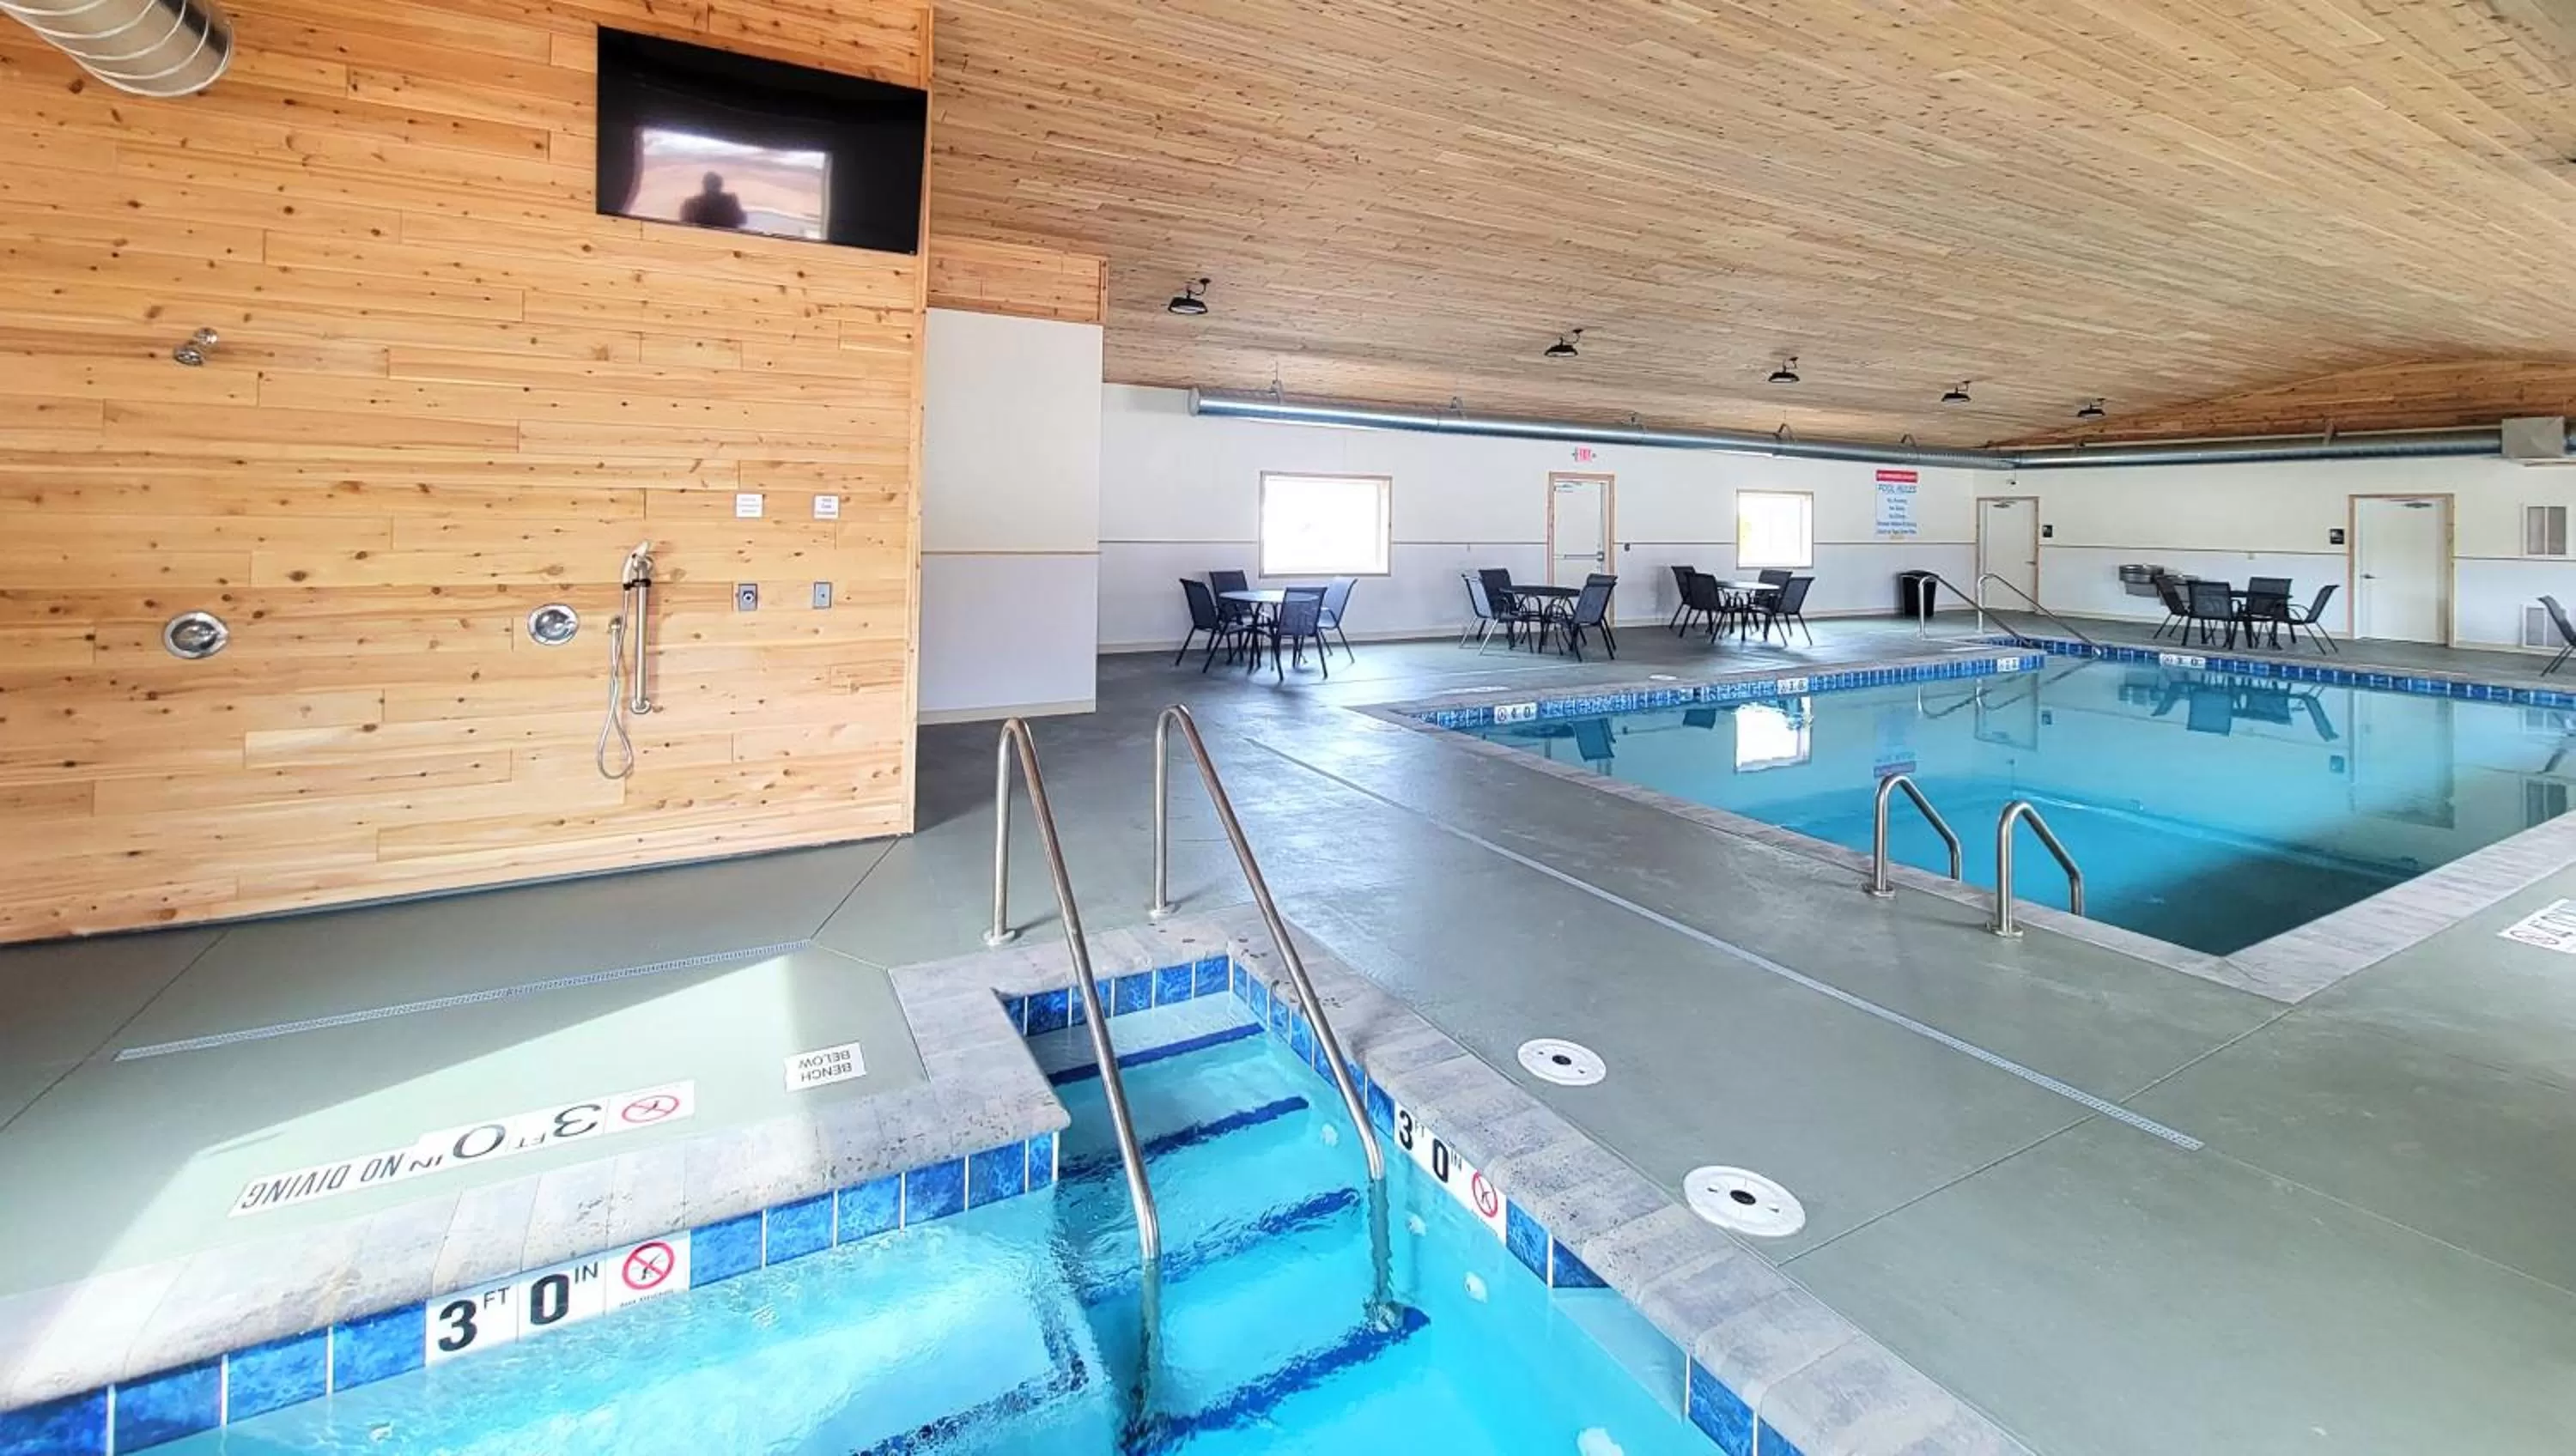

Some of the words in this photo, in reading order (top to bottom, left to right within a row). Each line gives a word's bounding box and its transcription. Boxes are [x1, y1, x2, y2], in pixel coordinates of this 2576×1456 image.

[798, 1050, 851, 1069] BELOW
[800, 1062, 853, 1083] BENCH
[553, 1104, 602, 1138] 3
[453, 1124, 507, 1160] 0
[515, 1132, 547, 1149] FT
[1398, 1109, 1413, 1151] 3
[1432, 1138, 1449, 1184] 0
[359, 1152, 414, 1183] NO
[408, 1154, 444, 1173] IN
[240, 1164, 352, 1210] DIVING
[438, 1299, 478, 1352] 3
[483, 1285, 511, 1311] FT
[530, 1273, 570, 1326] 0
[574, 1260, 599, 1285] IN
